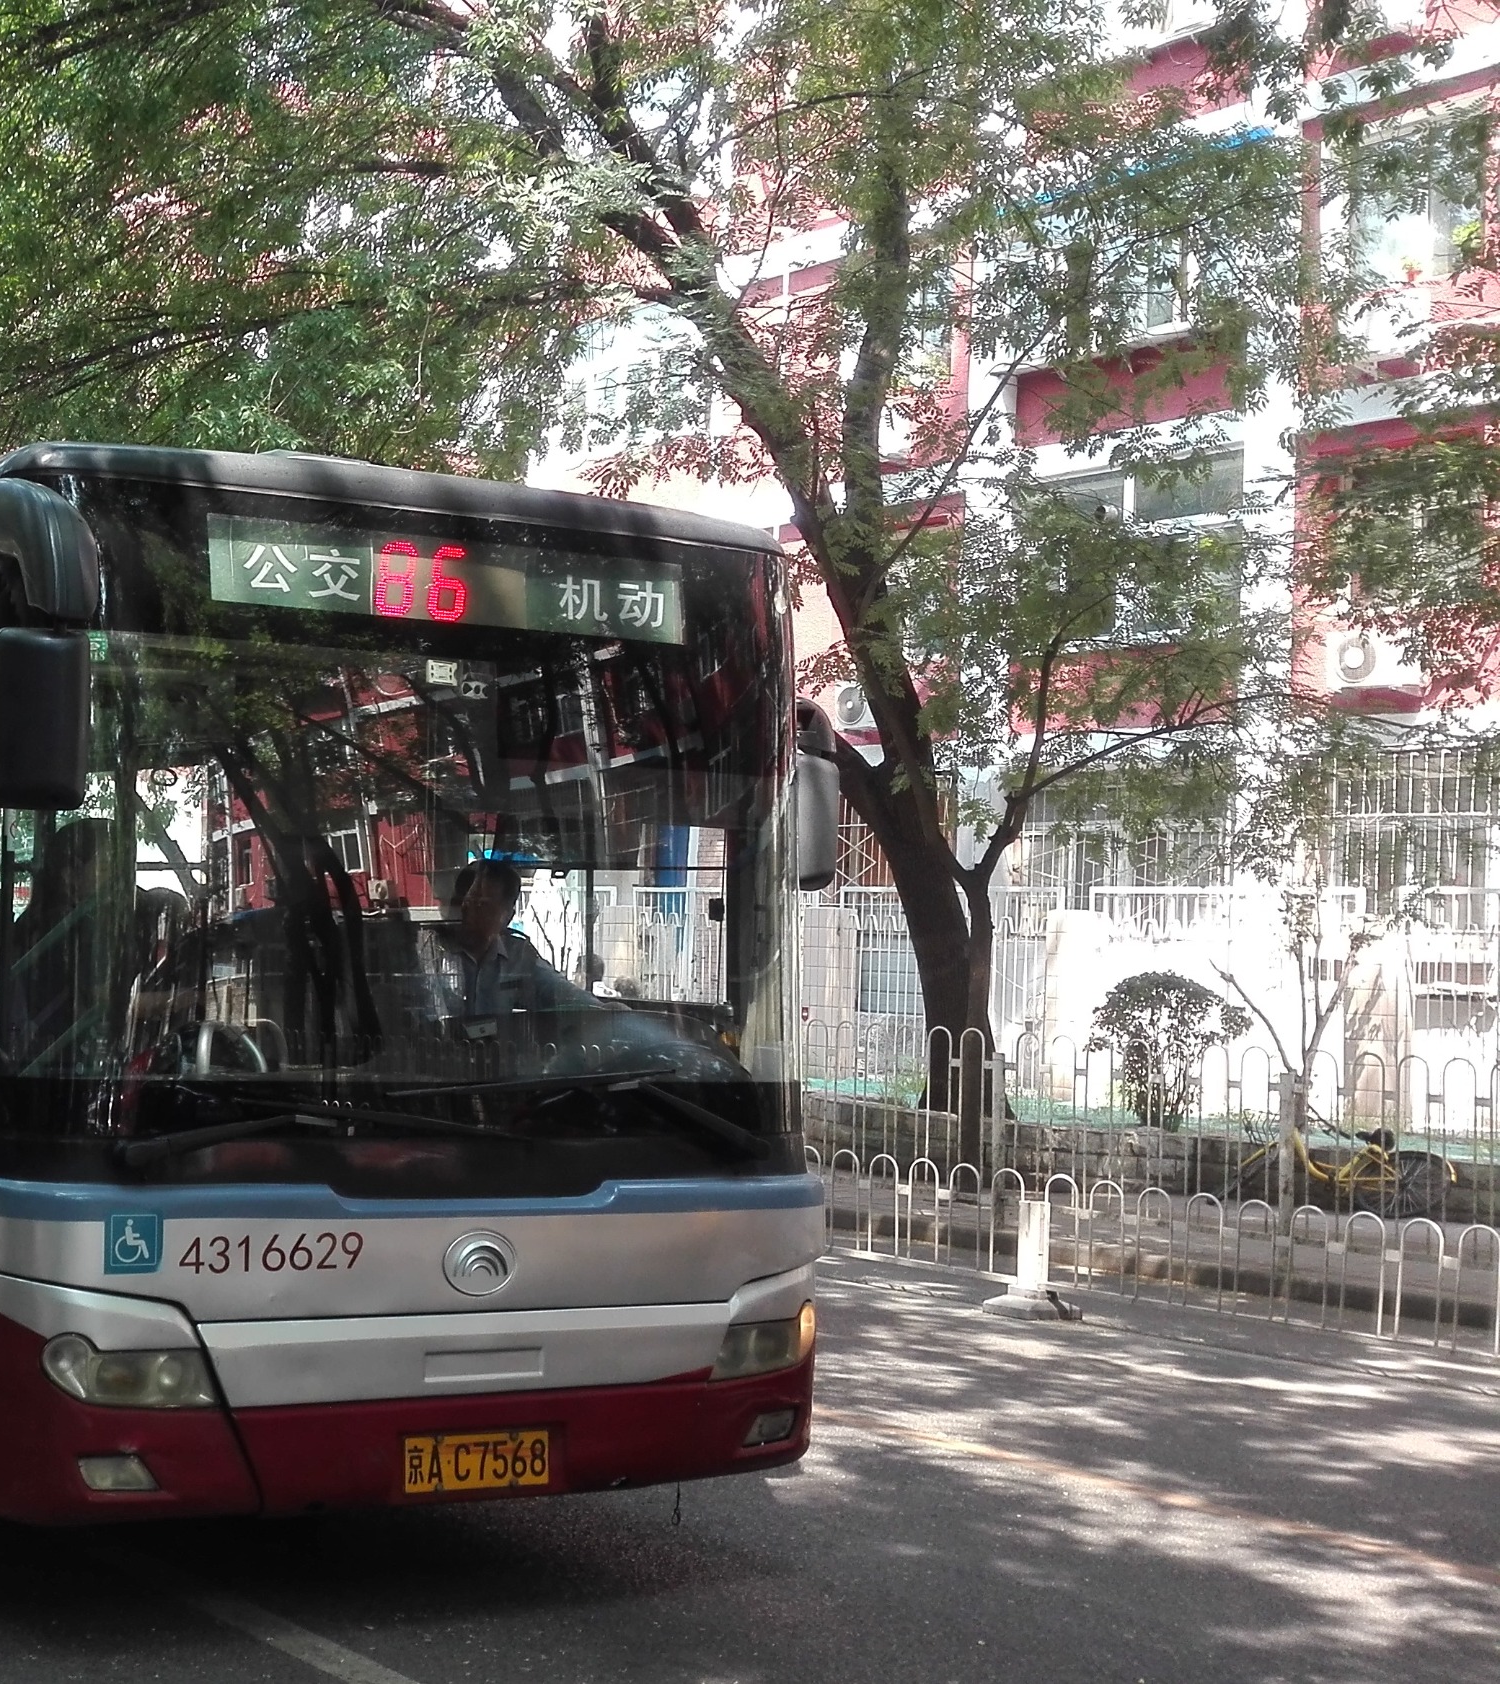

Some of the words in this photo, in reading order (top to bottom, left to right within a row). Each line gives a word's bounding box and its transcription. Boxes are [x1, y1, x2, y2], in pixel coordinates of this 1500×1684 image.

[243, 544, 361, 601] 公交
[374, 540, 468, 622] 86
[558, 575, 665, 629] 机动
[179, 1231, 364, 1275] 4316629
